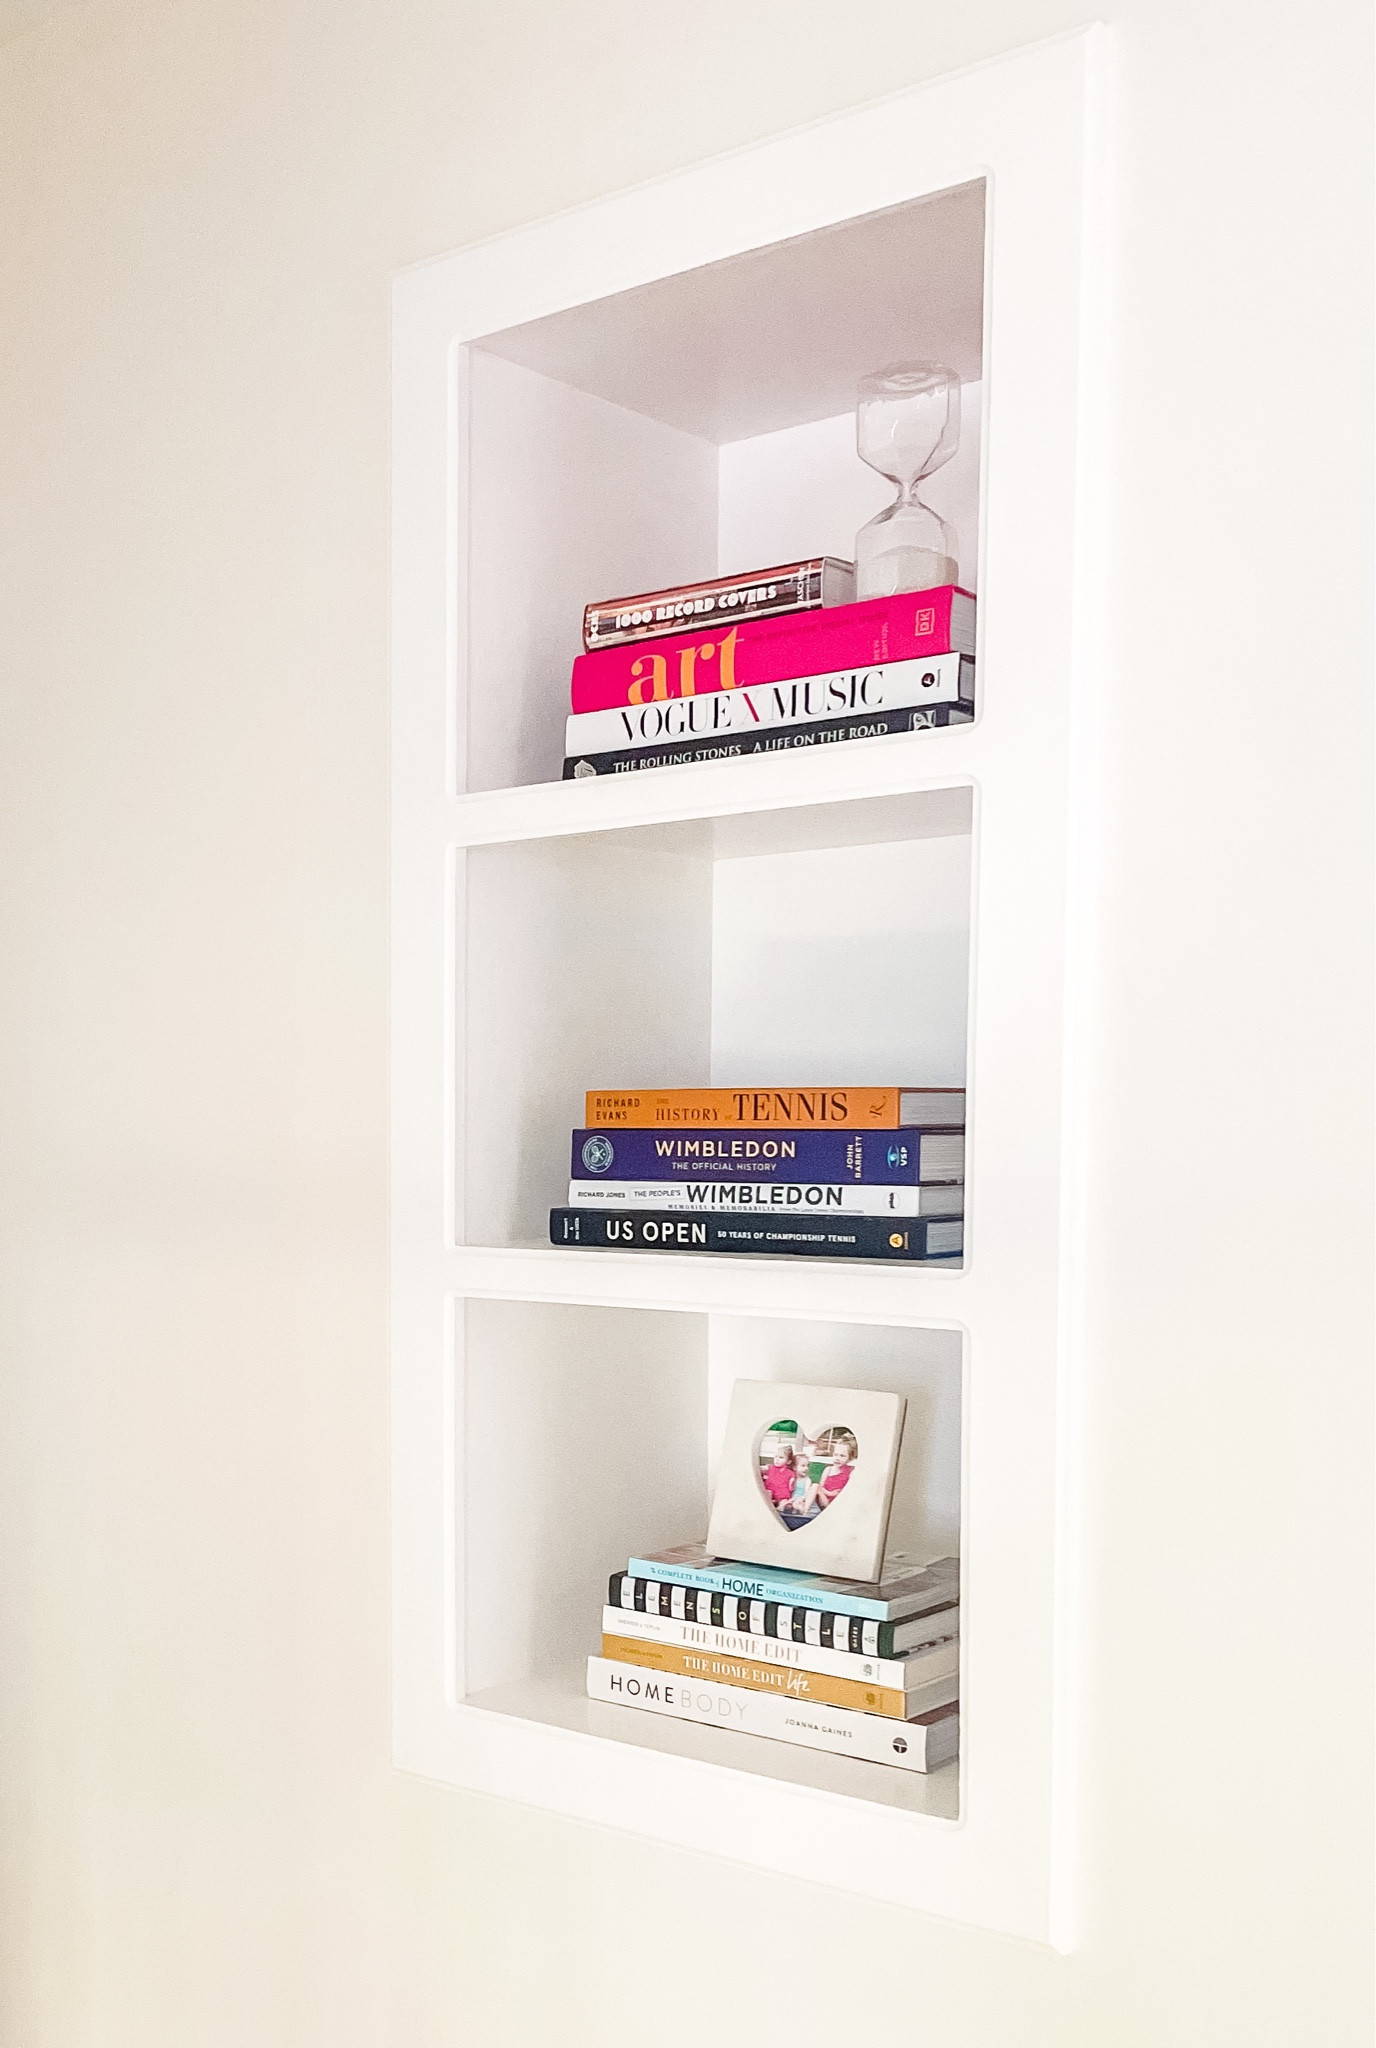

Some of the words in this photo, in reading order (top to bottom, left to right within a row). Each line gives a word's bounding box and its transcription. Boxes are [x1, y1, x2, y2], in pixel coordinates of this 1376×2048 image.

[615, 609, 652, 628] 1000
[656, 597, 715, 620] RECORD
[719, 585, 777, 609] COVERS
[919, 611, 930, 631] DK
[627, 626, 745, 705] art
[621, 695, 731, 741] VOGUE
[771, 671, 884, 721] MUSIC
[754, 740, 762, 752] A
[765, 736, 791, 751] LIFE
[794, 733, 815, 747] ON
[819, 727, 846, 743] THE
[849, 722, 889, 740] ROAD
[613, 761, 638, 773] THE
[640, 751, 692, 770] ROLLING
[695, 745, 742, 762] STONES
[596, 1098, 640, 1107] RICHARD
[656, 1108, 721, 1121] HISTORY
[733, 1092, 848, 1121] TENNIS
[596, 1111, 628, 1120] EVANS
[655, 1140, 796, 1158] WIMBLEDON
[854, 1136, 863, 1178] BARRETT
[900, 1147, 908, 1166] VSP
[672, 1162, 688, 1170] THE
[692, 1162, 733, 1171] OFFICIAL
[737, 1163, 776, 1171] HISTORY
[686, 1185, 843, 1205] WIMBLEDON
[606, 1220, 634, 1240] US
[642, 1222, 707, 1243] OPEN
[728, 1231, 751, 1239] YEARS
[766, 1232, 826, 1242] CHAMPIONSHIP
[828, 1234, 856, 1243] TENNIS
[721, 1577, 764, 1597] HOME
[765, 1588, 823, 1604] ORGANIZATION
[680, 1626, 711, 1645] THE
[715, 1633, 761, 1655] HOME
[765, 1642, 802, 1663] EDIT
[683, 1655, 710, 1672] THE
[712, 1662, 749, 1680] HOME
[752, 1669, 785, 1687] EDIT
[786, 1669, 811, 1697] life
[785, 1718, 819, 1731] JOANNA
[822, 1726, 853, 1738] GAINES
